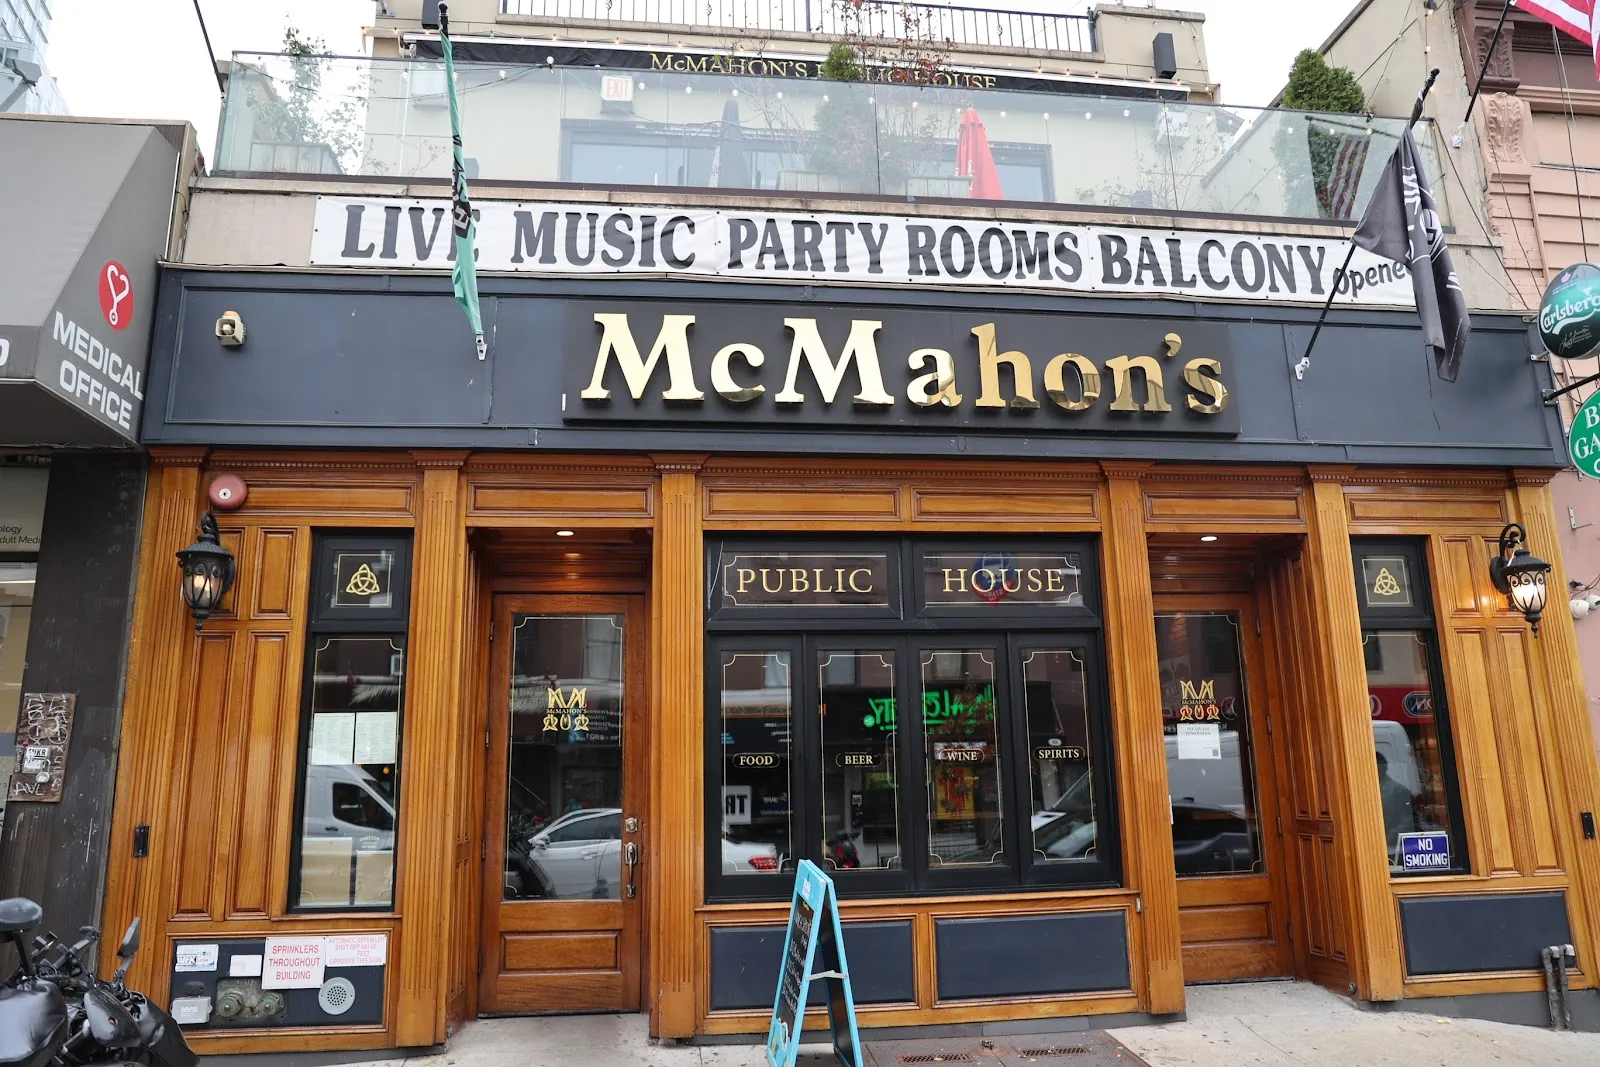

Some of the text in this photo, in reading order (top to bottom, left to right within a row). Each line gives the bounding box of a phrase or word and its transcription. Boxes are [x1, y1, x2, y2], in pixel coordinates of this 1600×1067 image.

[606, 79, 628, 98] EXIT
[510, 211, 695, 269] MUSIC
[727, 218, 888, 274] PARTY
[905, 225, 1083, 283] ROOMS
[1098, 234, 1325, 294] BALCONY
[1332, 260, 1411, 298] opene
[53, 310, 143, 401] MEDICAL
[580, 313, 1230, 414] McMahon's
[60, 360, 132, 430] OFFICE
[736, 568, 873, 593] PUBLIC
[942, 567, 1065, 593] HOUSE
[739, 756, 773, 765] FOOD
[844, 754, 873, 765] BEER
[947, 751, 978, 761] WINE
[1038, 749, 1080, 759] SPIRITS
[1418, 838, 1433, 851] NO
[1405, 852, 1449, 867] SMOKING
[272, 944, 319, 955] SPRINKLERS
[269, 957, 320, 967] THROUGHOUT
[276, 970, 311, 980] BUILDING
